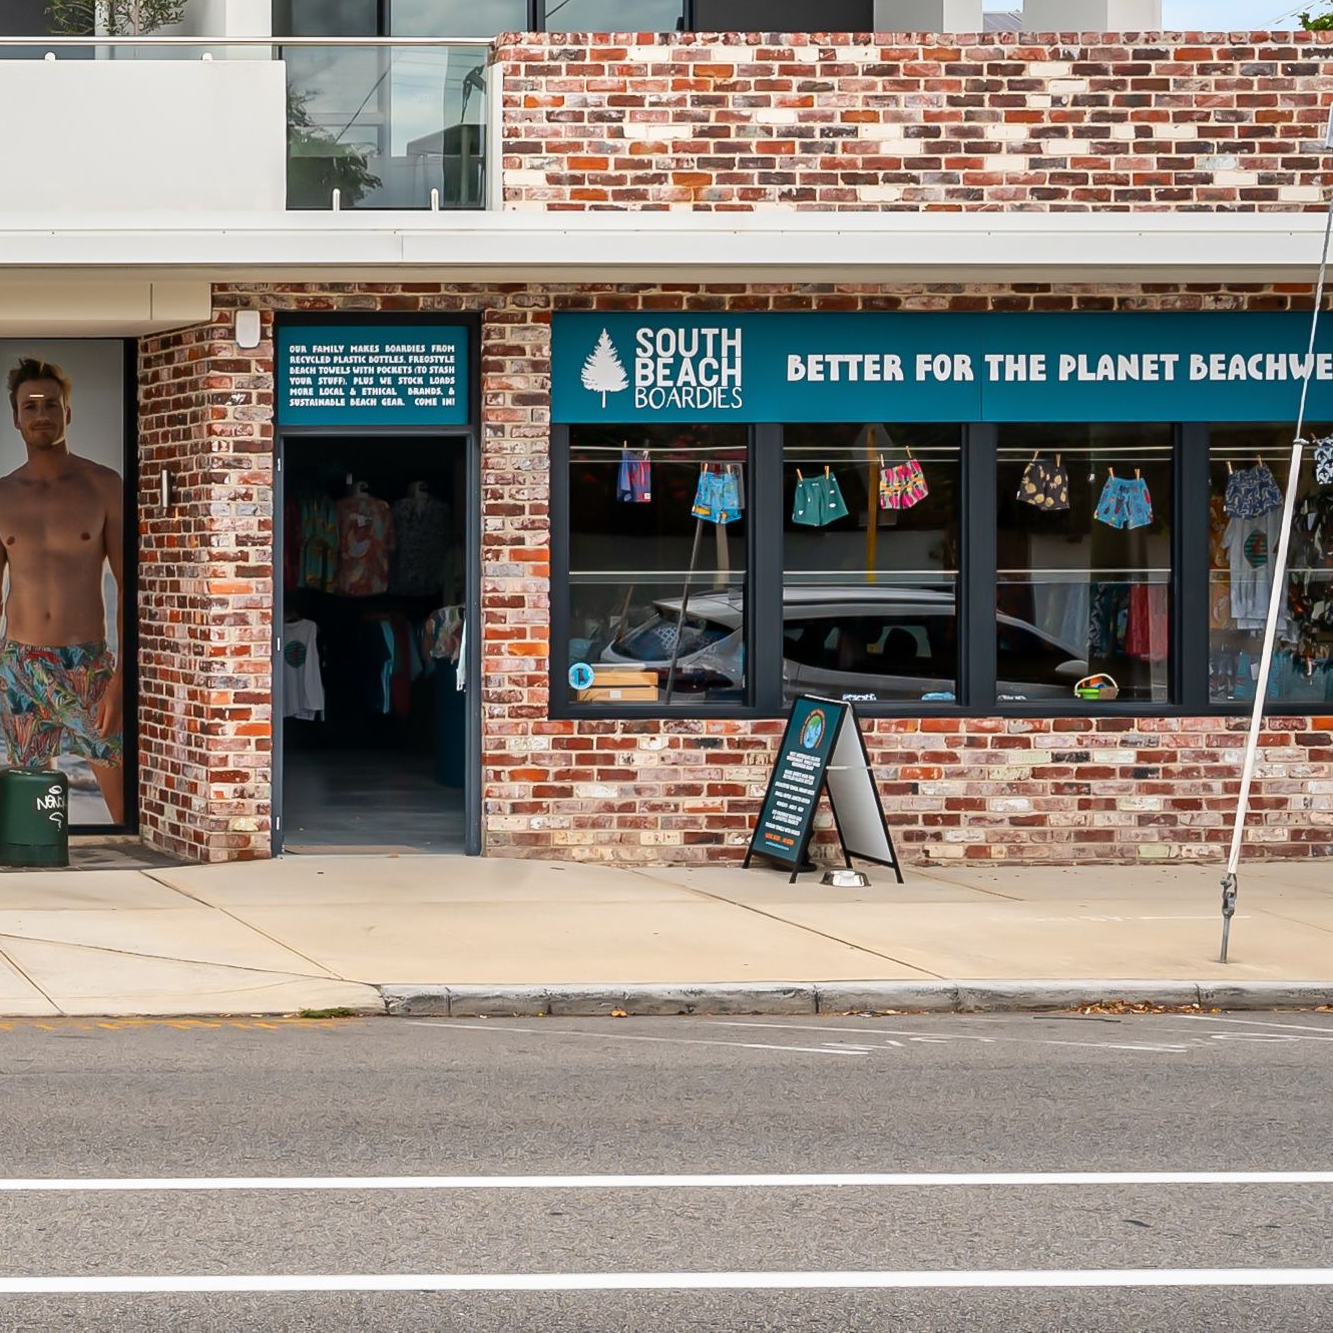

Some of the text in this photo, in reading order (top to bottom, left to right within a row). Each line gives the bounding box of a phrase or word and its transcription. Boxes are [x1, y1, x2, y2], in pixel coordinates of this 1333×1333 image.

[636, 328, 742, 357] SOUTH
[290, 344, 455, 353] OUR FAMILY MAKES BOARDIES FROM
[290, 355, 331, 364] RECYCLED
[334, 355, 367, 364] PLASTIC
[407, 355, 455, 364] FREOSTYLE
[290, 366, 316, 375] BEACH
[318, 366, 351, 375] TOWELS
[353, 366, 375, 375] WITH
[377, 366, 412, 375] POCKETS
[429, 366, 455, 375] STASH
[787, 353, 1333, 381] BETTER FOR THE PLANET BEACHWE
[635, 358, 742, 387] BEACH
[290, 376, 313, 385] YOUR
[354, 376, 374, 385] PLUS
[380, 376, 393, 385] WE
[398, 376, 424, 385] STOCK
[430, 376, 456, 385] LOADS
[290, 387, 314, 396] MORE
[320, 387, 345, 396] LOCAL
[350, 387, 356, 396] &
[362, 387, 398, 396] ETHICAL
[449, 387, 455, 396] &
[290, 397, 346, 406] SUSTAINABLE
[350, 397, 377, 406] BEACH
[415, 397, 438, 406] COME
[442, 397, 455, 406] IN!
[635, 387, 743, 409] BOARDIES
